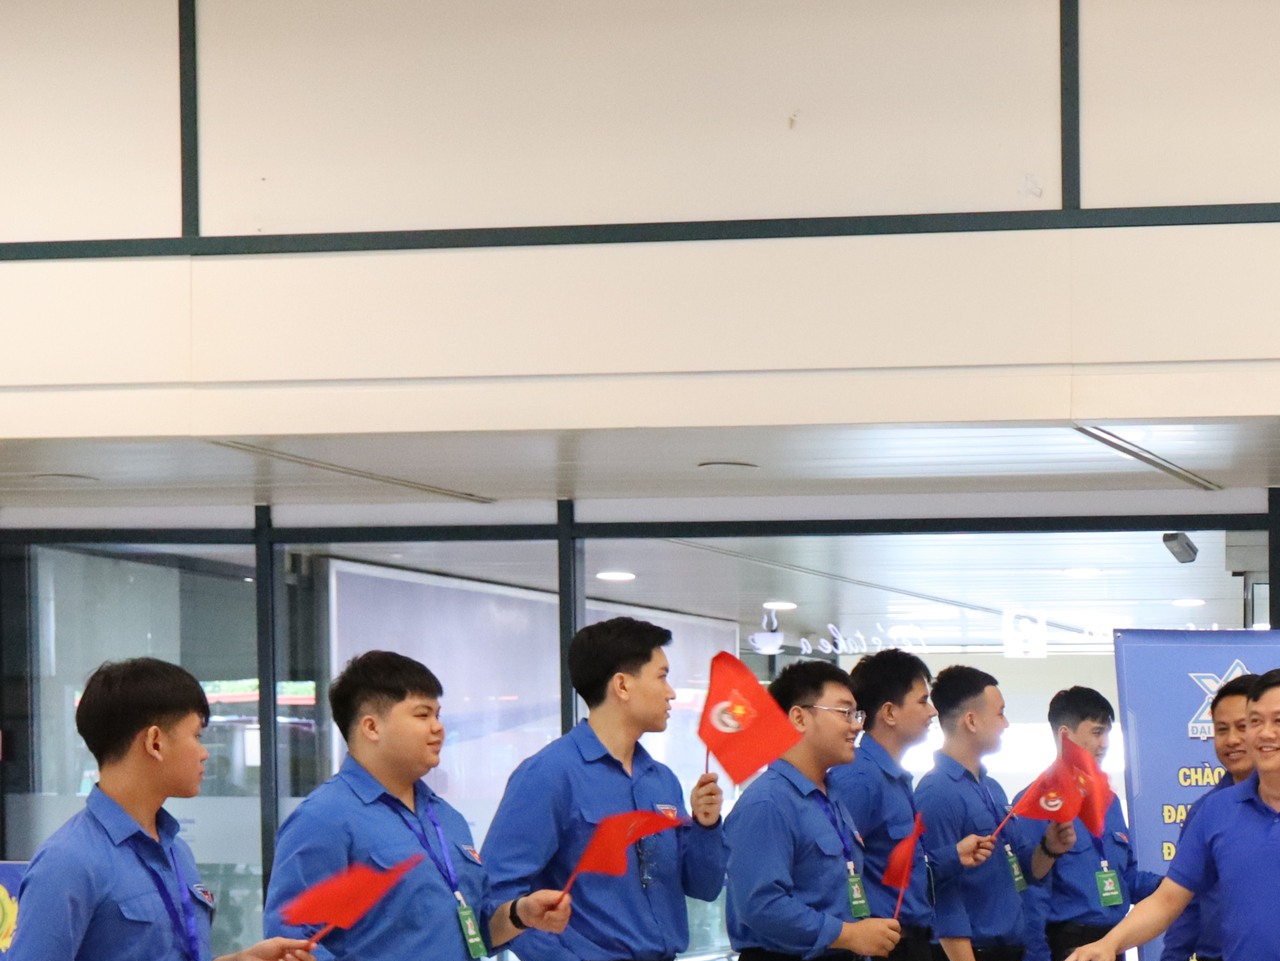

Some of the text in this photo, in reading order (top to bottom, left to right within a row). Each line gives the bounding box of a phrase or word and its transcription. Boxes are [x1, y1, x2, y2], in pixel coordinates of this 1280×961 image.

[1191, 725, 1212, 740] ĐẠI
[1178, 762, 1226, 787] CHÀO
[1162, 804, 1192, 828] ĐẠ
